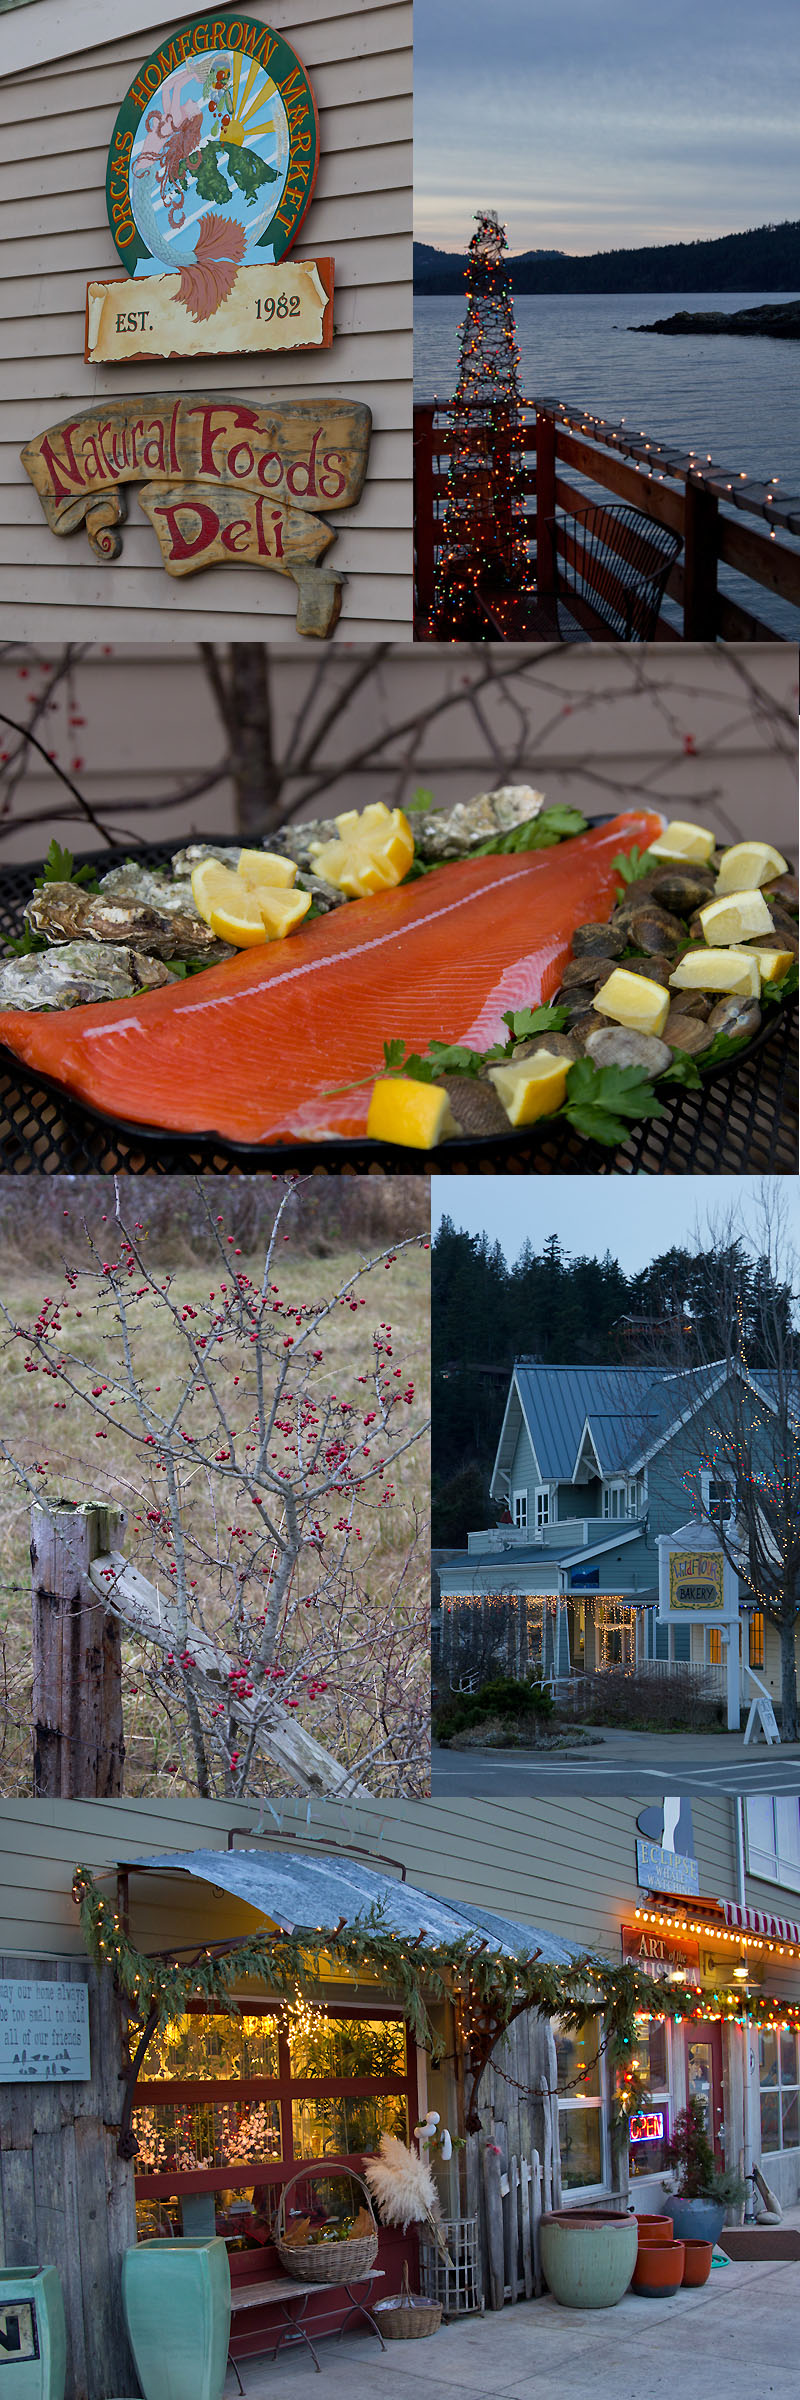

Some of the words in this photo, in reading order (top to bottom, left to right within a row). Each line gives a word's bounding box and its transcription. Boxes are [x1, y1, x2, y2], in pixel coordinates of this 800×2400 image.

[114, 131, 135, 249] ORCAS
[128, 21, 279, 111] HOMEGROWN
[276, 66, 312, 238] MARKET
[115, 310, 154, 334] EST.
[254, 293, 301, 322] 1982
[39, 399, 182, 508] Natural
[187, 404, 346, 499] Foods
[154, 496, 285, 562] Deli
[680, 1587, 714, 1601] BAKERY
[641, 1843, 697, 1881] ECLIPSE
[656, 1865, 686, 1884] WHALE
[638, 1934, 666, 1960] ART
[17, 1986, 32, 1999] our
[35, 1983, 54, 2000] home
[57, 1984, 84, 2005] always
[12, 2006, 26, 2022] too
[29, 2005, 52, 2022] small
[55, 2009, 64, 2022] to
[66, 2004, 85, 2023] hold
[4, 2028, 19, 2046] all
[22, 2028, 31, 2046] of
[34, 2032, 48, 2046] our
[51, 2028, 82, 2046] friends
[630, 2115, 663, 2140] OPEN
